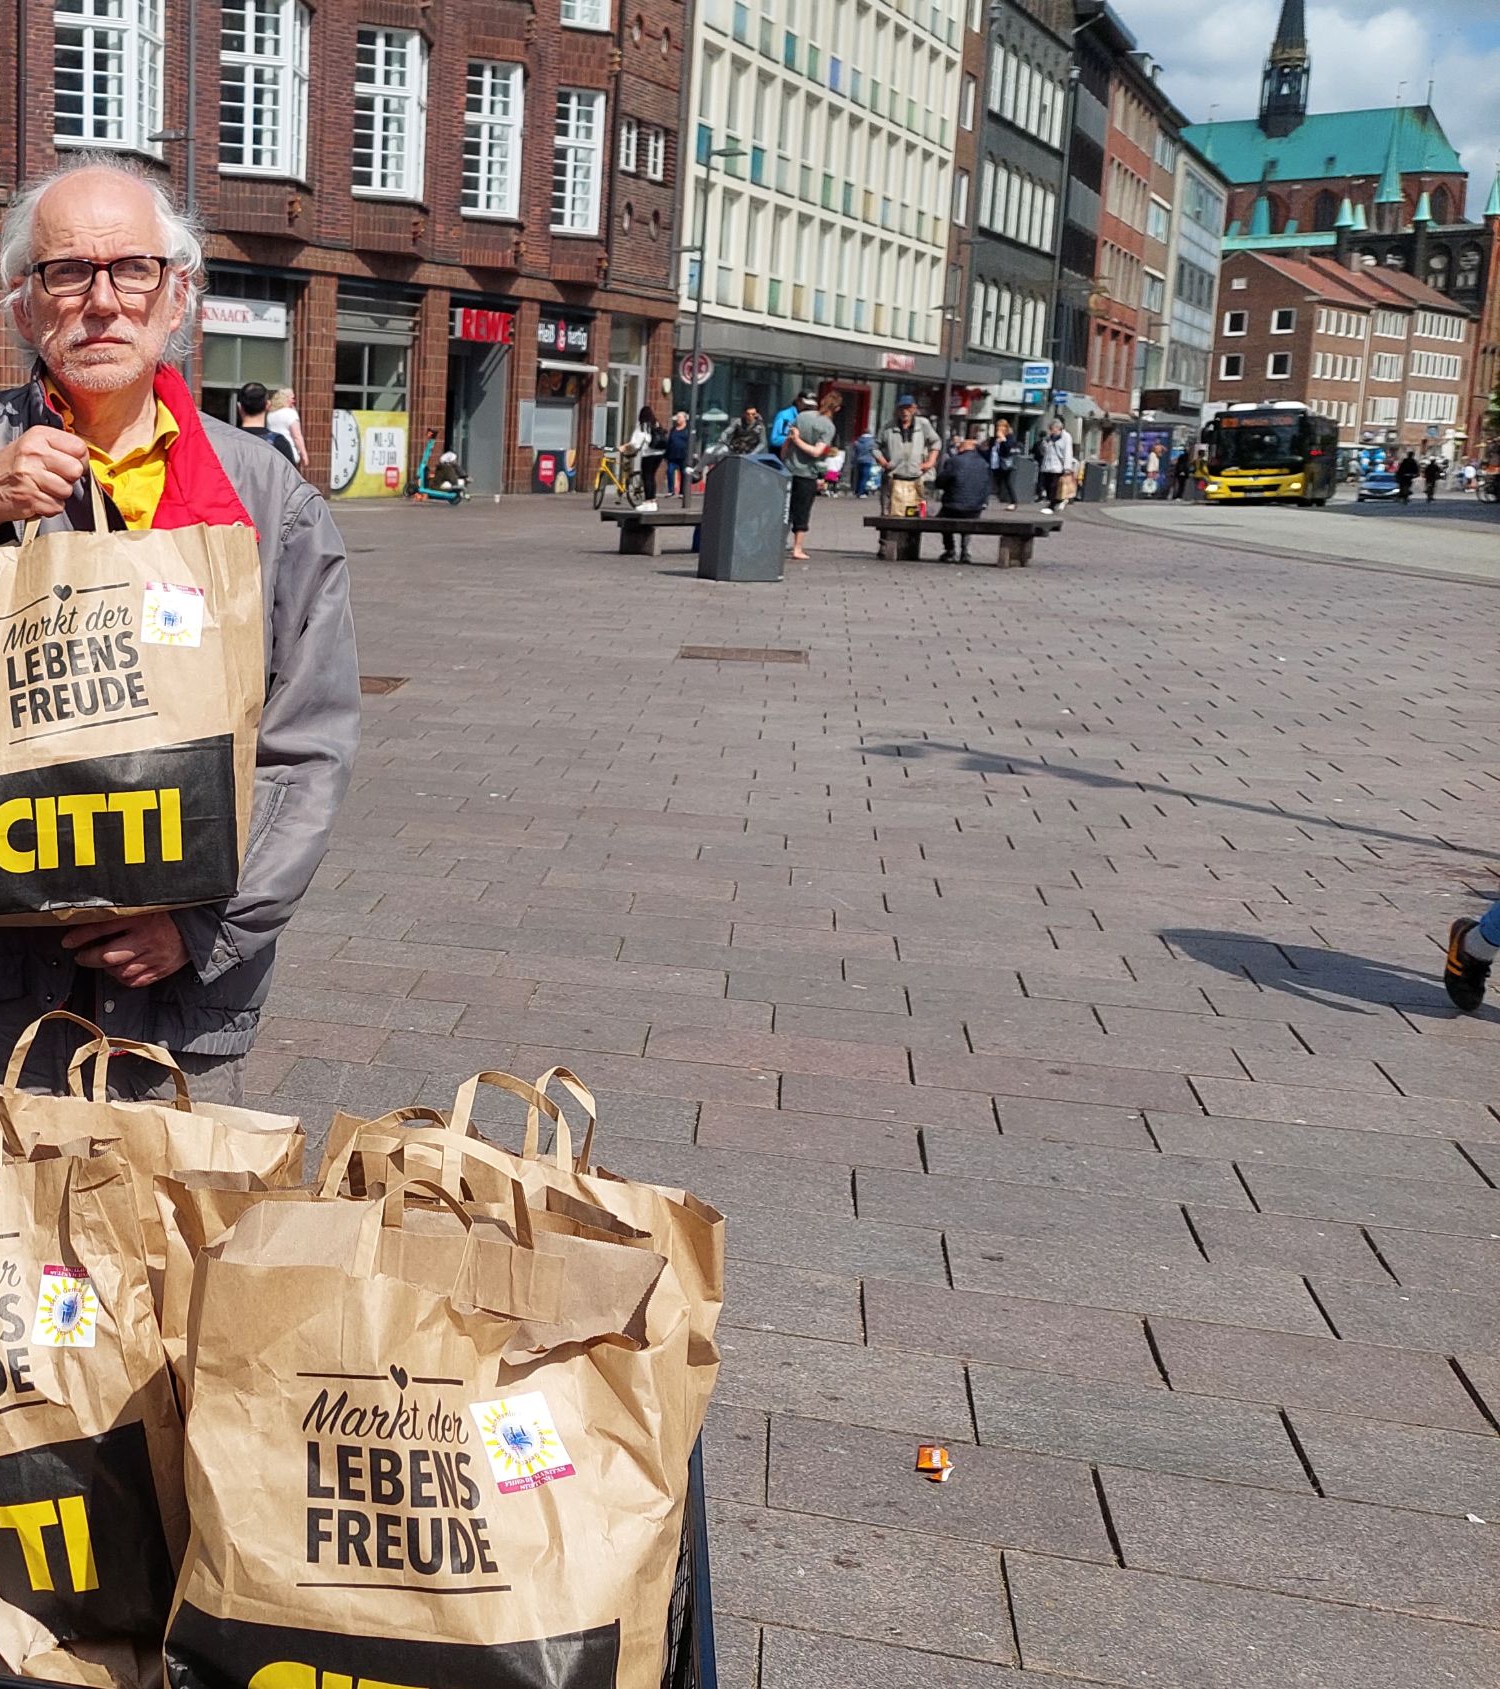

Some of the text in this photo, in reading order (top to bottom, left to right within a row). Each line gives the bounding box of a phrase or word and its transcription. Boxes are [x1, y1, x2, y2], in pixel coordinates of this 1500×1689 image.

[462, 307, 514, 345] REWE
[2, 602, 78, 654] Markt
[85, 600, 132, 632] der
[6, 631, 139, 691] LEBENS
[9, 671, 150, 729] FREUDE
[302, 1388, 424, 1441] Markt
[428, 1397, 469, 1444] der
[307, 1441, 480, 1511] LEBENS
[306, 1507, 499, 1576] FREUDE
